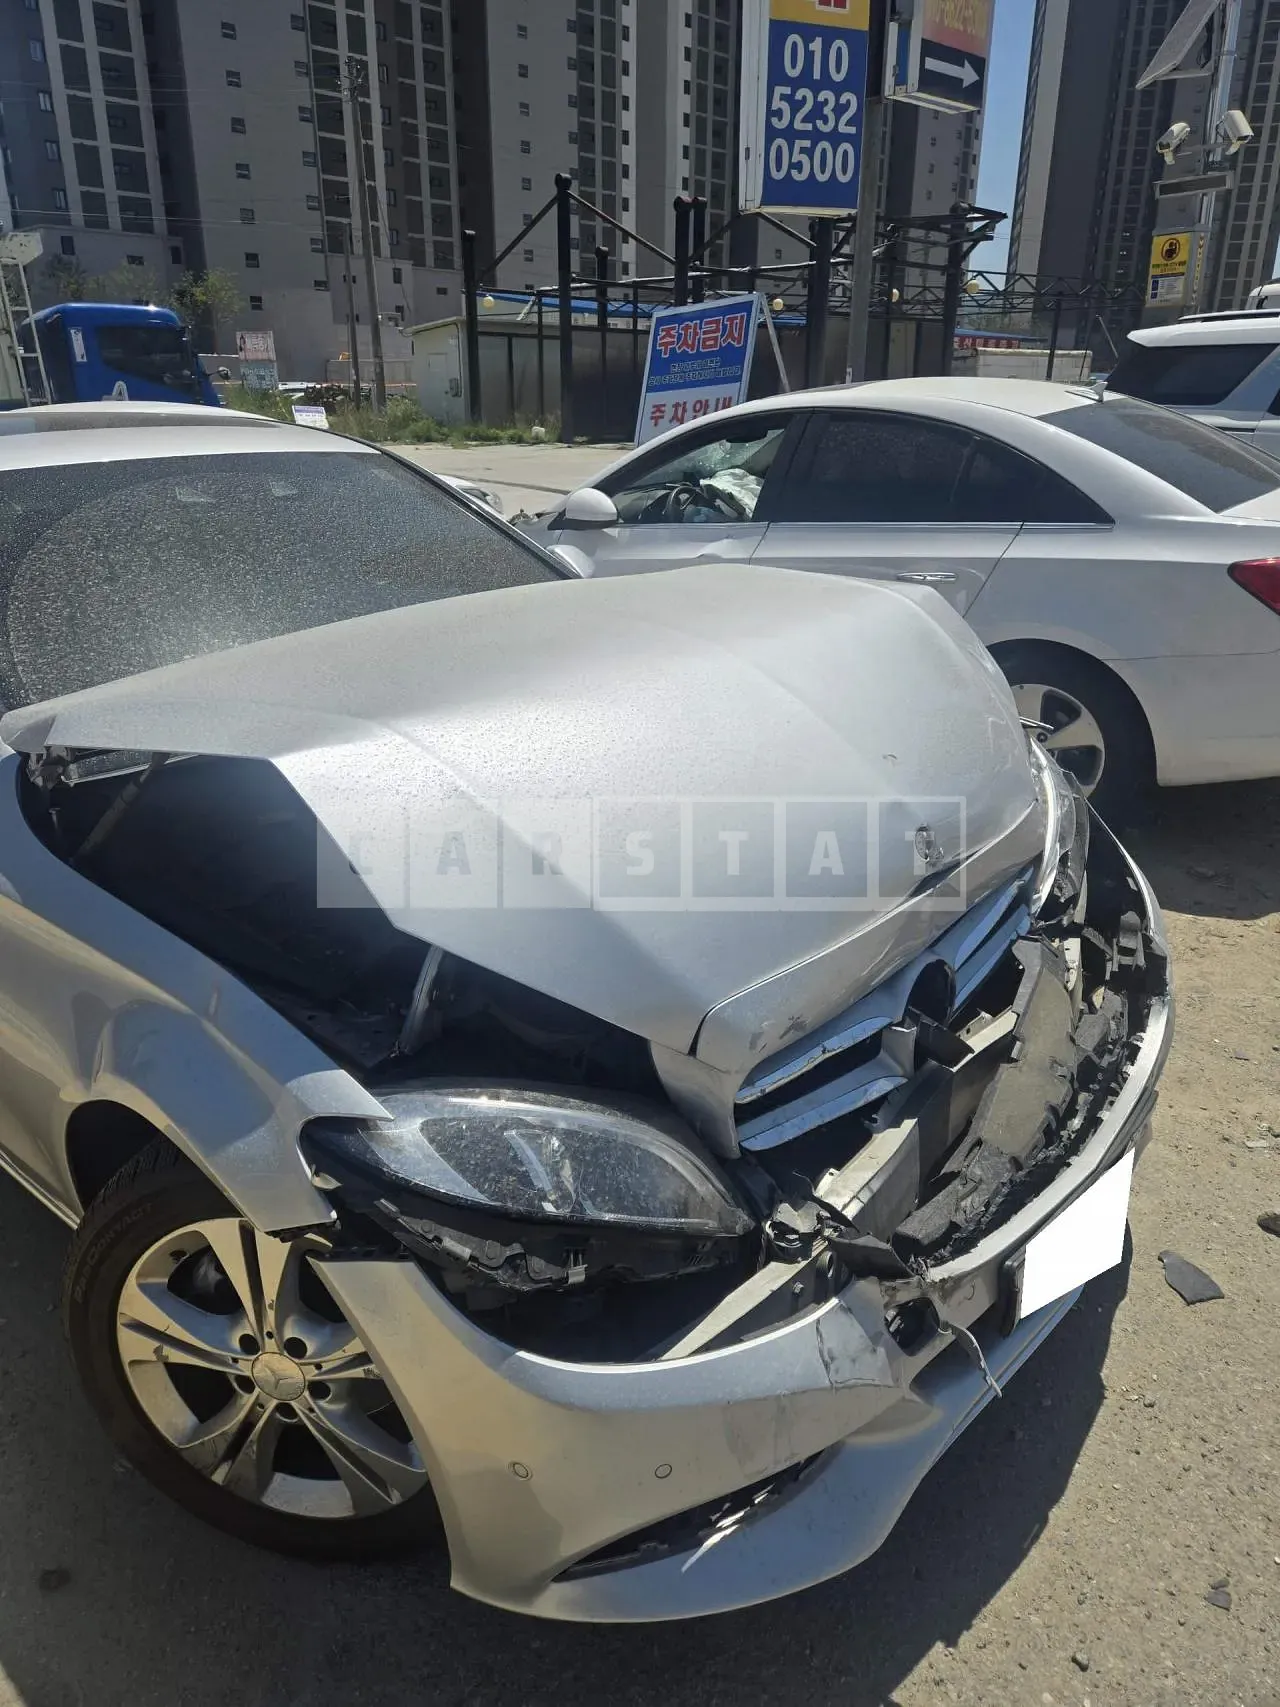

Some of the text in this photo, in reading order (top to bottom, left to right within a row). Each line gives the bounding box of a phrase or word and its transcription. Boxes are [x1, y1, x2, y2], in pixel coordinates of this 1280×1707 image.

[784, 33, 850, 83] 010
[770, 85, 859, 134] 5232
[769, 137, 855, 184] 0500
[656, 312, 748, 359] 주차금지
